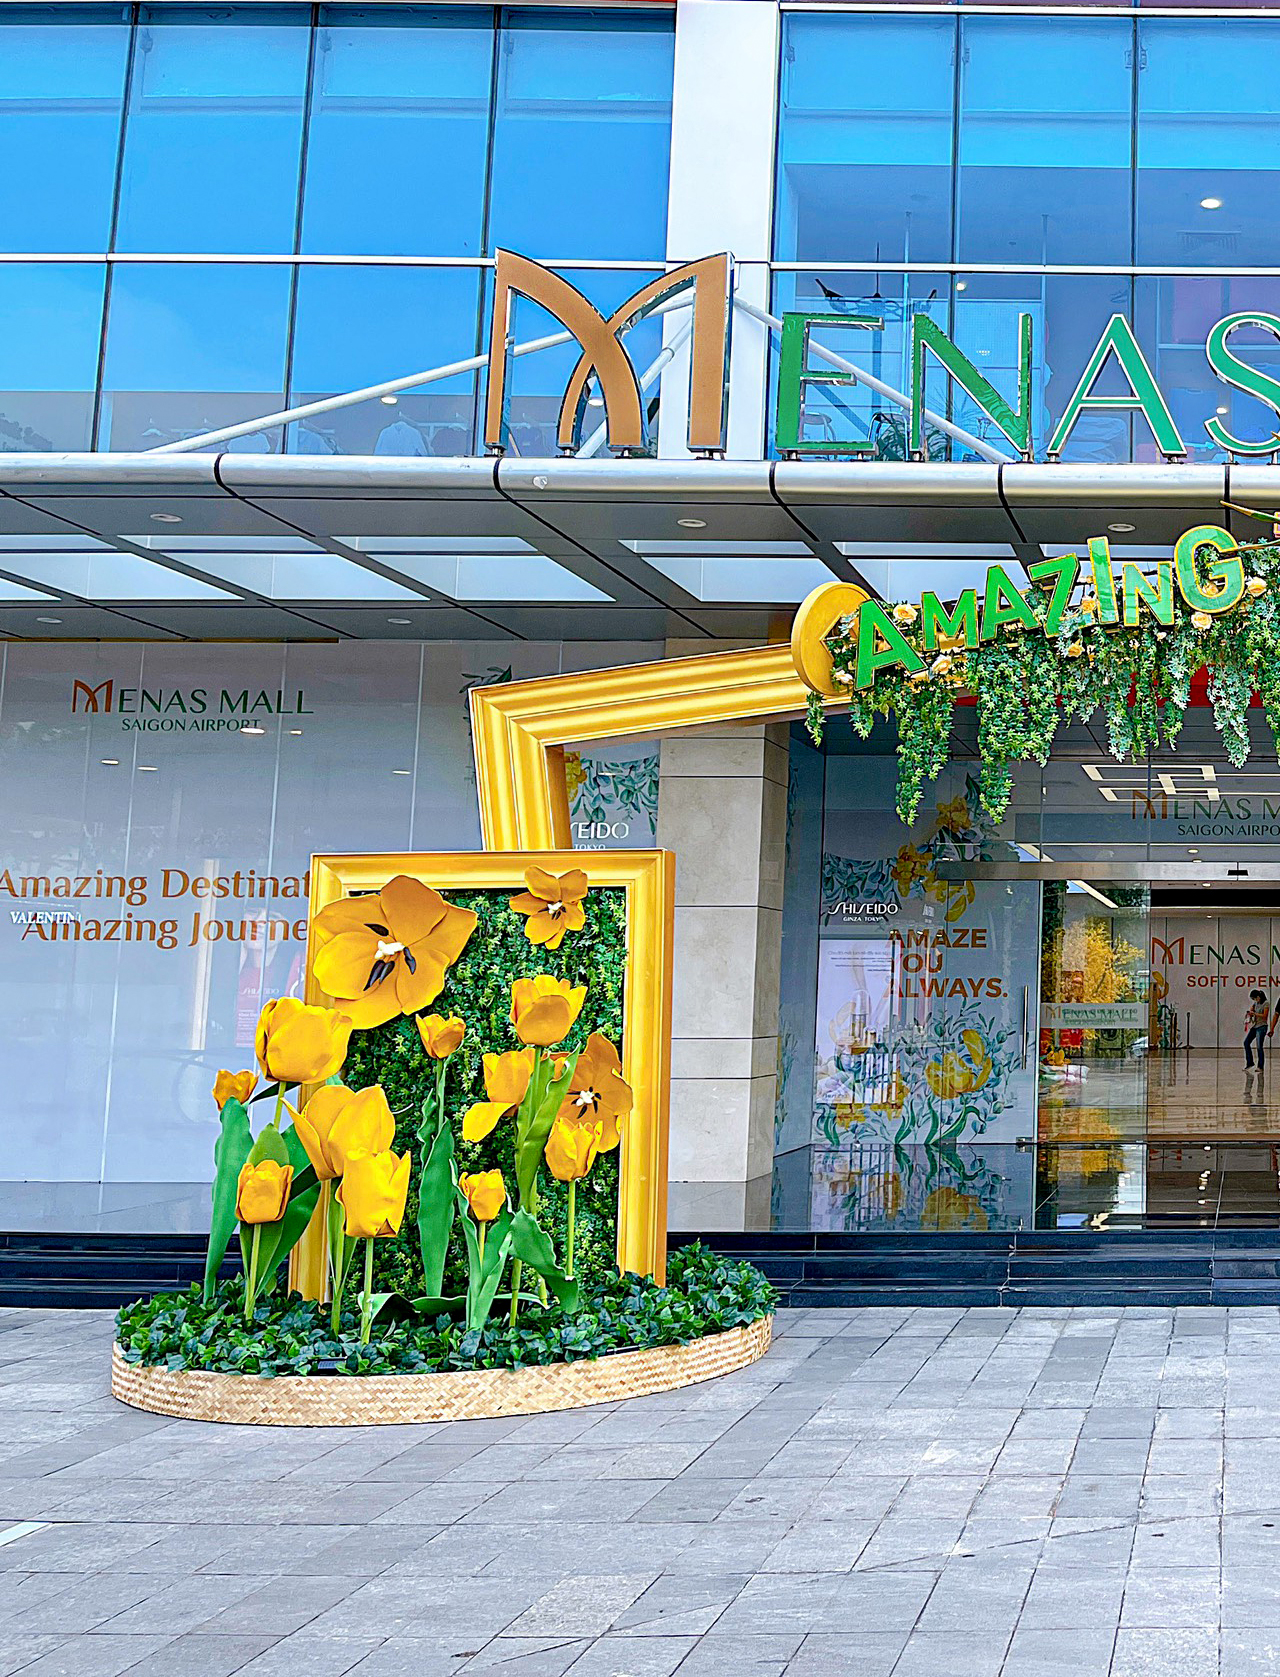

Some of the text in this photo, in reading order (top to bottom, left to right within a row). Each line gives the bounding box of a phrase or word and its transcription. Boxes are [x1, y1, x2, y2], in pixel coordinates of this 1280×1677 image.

[853, 525, 1246, 690] AMAZING
[72, 679, 314, 714] MENAS MALL
[122, 718, 261, 731] SAIGON AIRPORT
[1131, 789, 1251, 820] MENAS
[1177, 824, 1235, 836] SAIGON
[0, 868, 148, 906] Amazing
[828, 902, 898, 914] SHISEIDO
[21, 912, 178, 949] Amazing
[886, 929, 987, 948] AMAZE
[1151, 936, 1261, 966] MENAS
[889, 953, 943, 973] YOU
[884, 977, 1008, 998] ALWAYS.
[1186, 975, 1229, 988] SOFT
